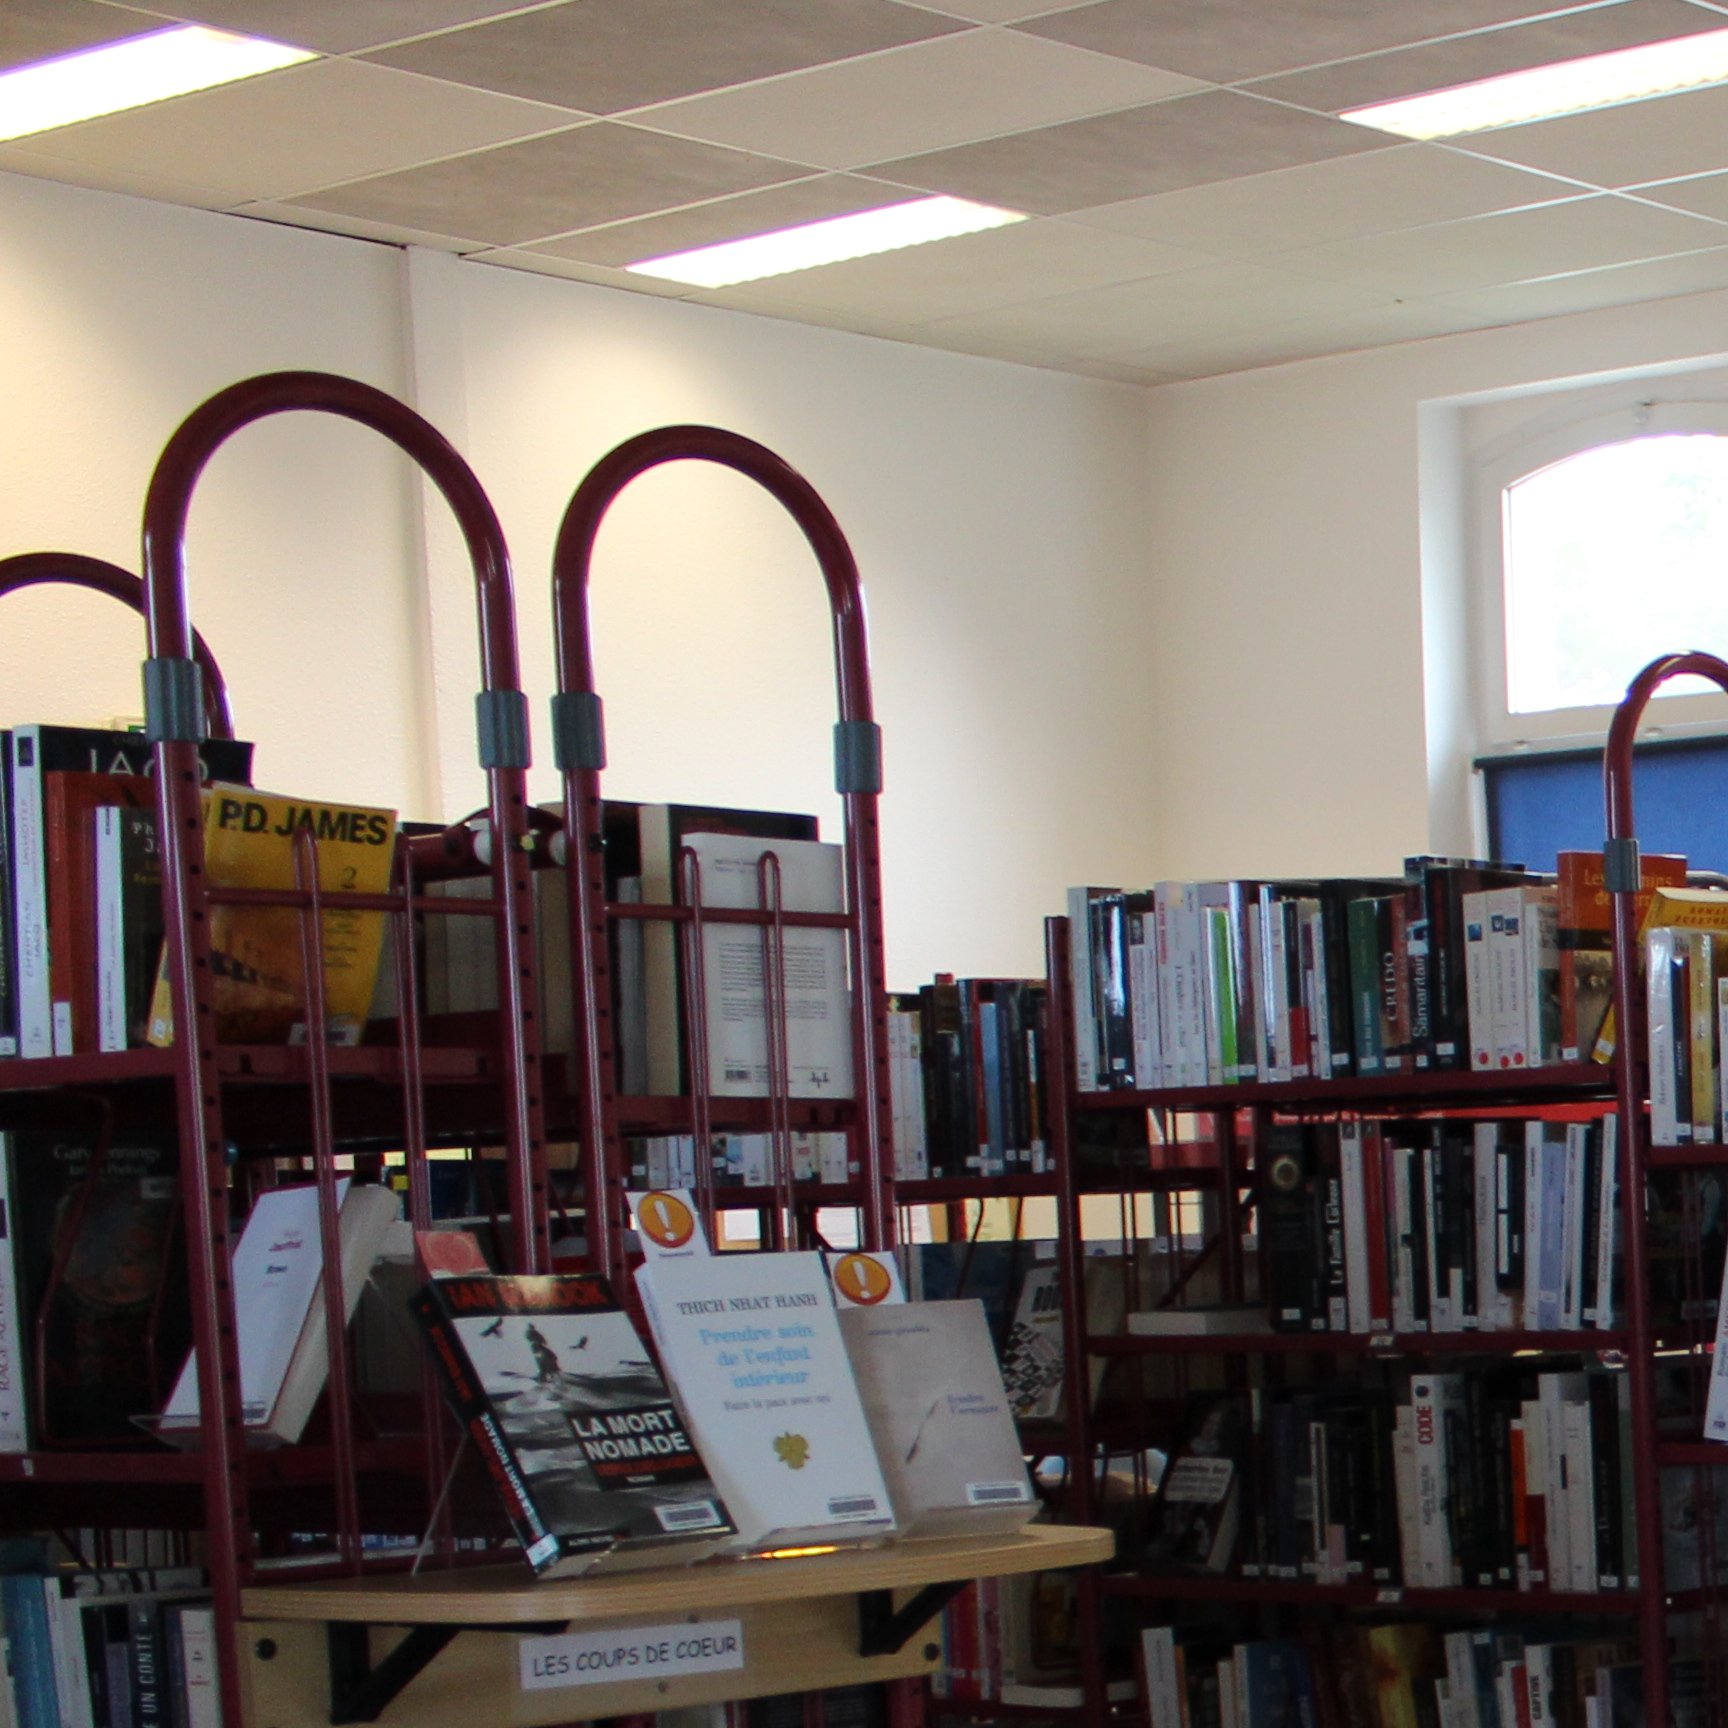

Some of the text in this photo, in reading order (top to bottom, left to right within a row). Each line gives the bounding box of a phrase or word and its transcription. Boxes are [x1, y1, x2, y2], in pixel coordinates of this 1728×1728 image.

[219, 798, 390, 846] P.D. JAMES
[1382, 951, 1398, 1021] CREDO
[676, 1293, 819, 1317] THICH NHAT HANH
[699, 1323, 815, 1345] Prendre soin
[716, 1348, 740, 1366] de
[572, 1409, 677, 1438] LA MORT
[1417, 1406, 1434, 1445] CODE
[583, 1432, 691, 1461] NOMADE
[136, 1631, 155, 1684] CONTE
[531, 1634, 737, 1679] LES COUPS DE COEUR
[140, 1690, 158, 1714] UN
